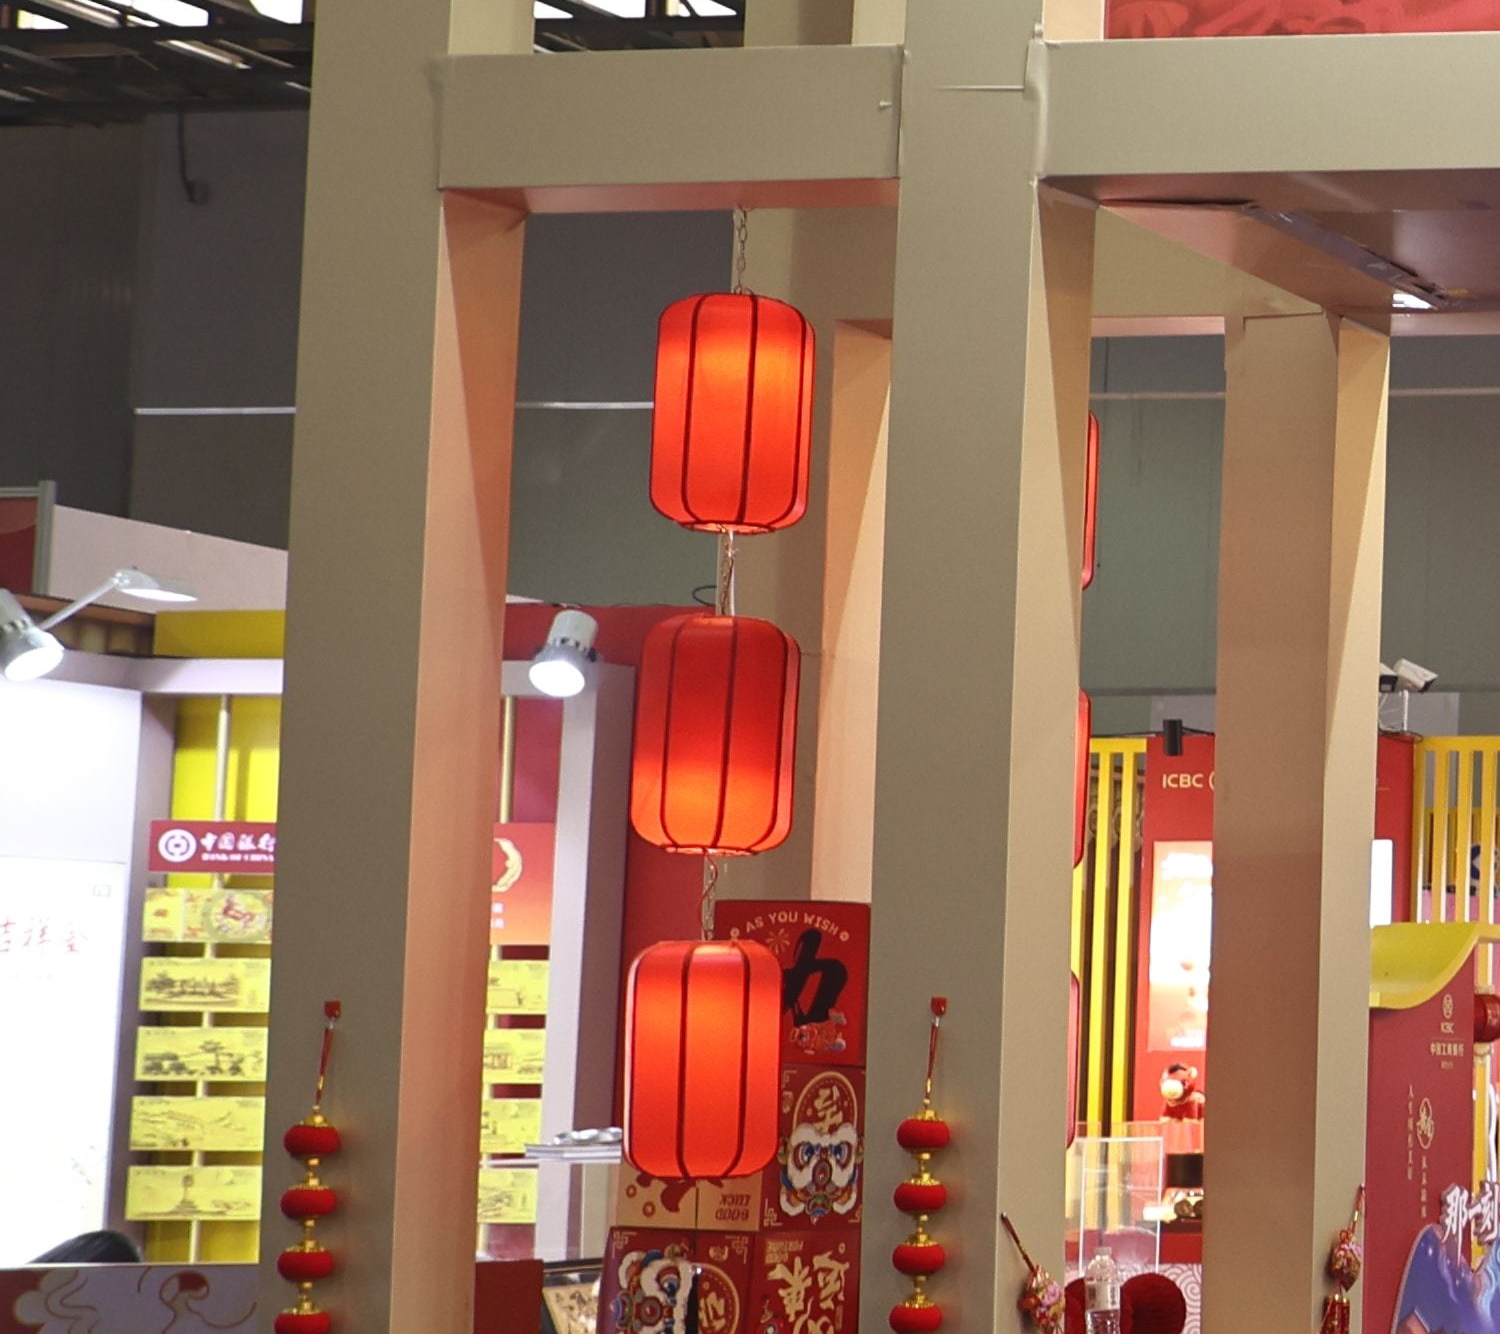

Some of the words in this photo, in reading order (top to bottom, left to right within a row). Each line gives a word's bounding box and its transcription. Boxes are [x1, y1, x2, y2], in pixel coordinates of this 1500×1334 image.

[1162, 773, 1204, 789] ICBC
[745, 915, 764, 933] AS
[769, 910, 798, 925] YOU
[803, 912, 840, 935] WISH
